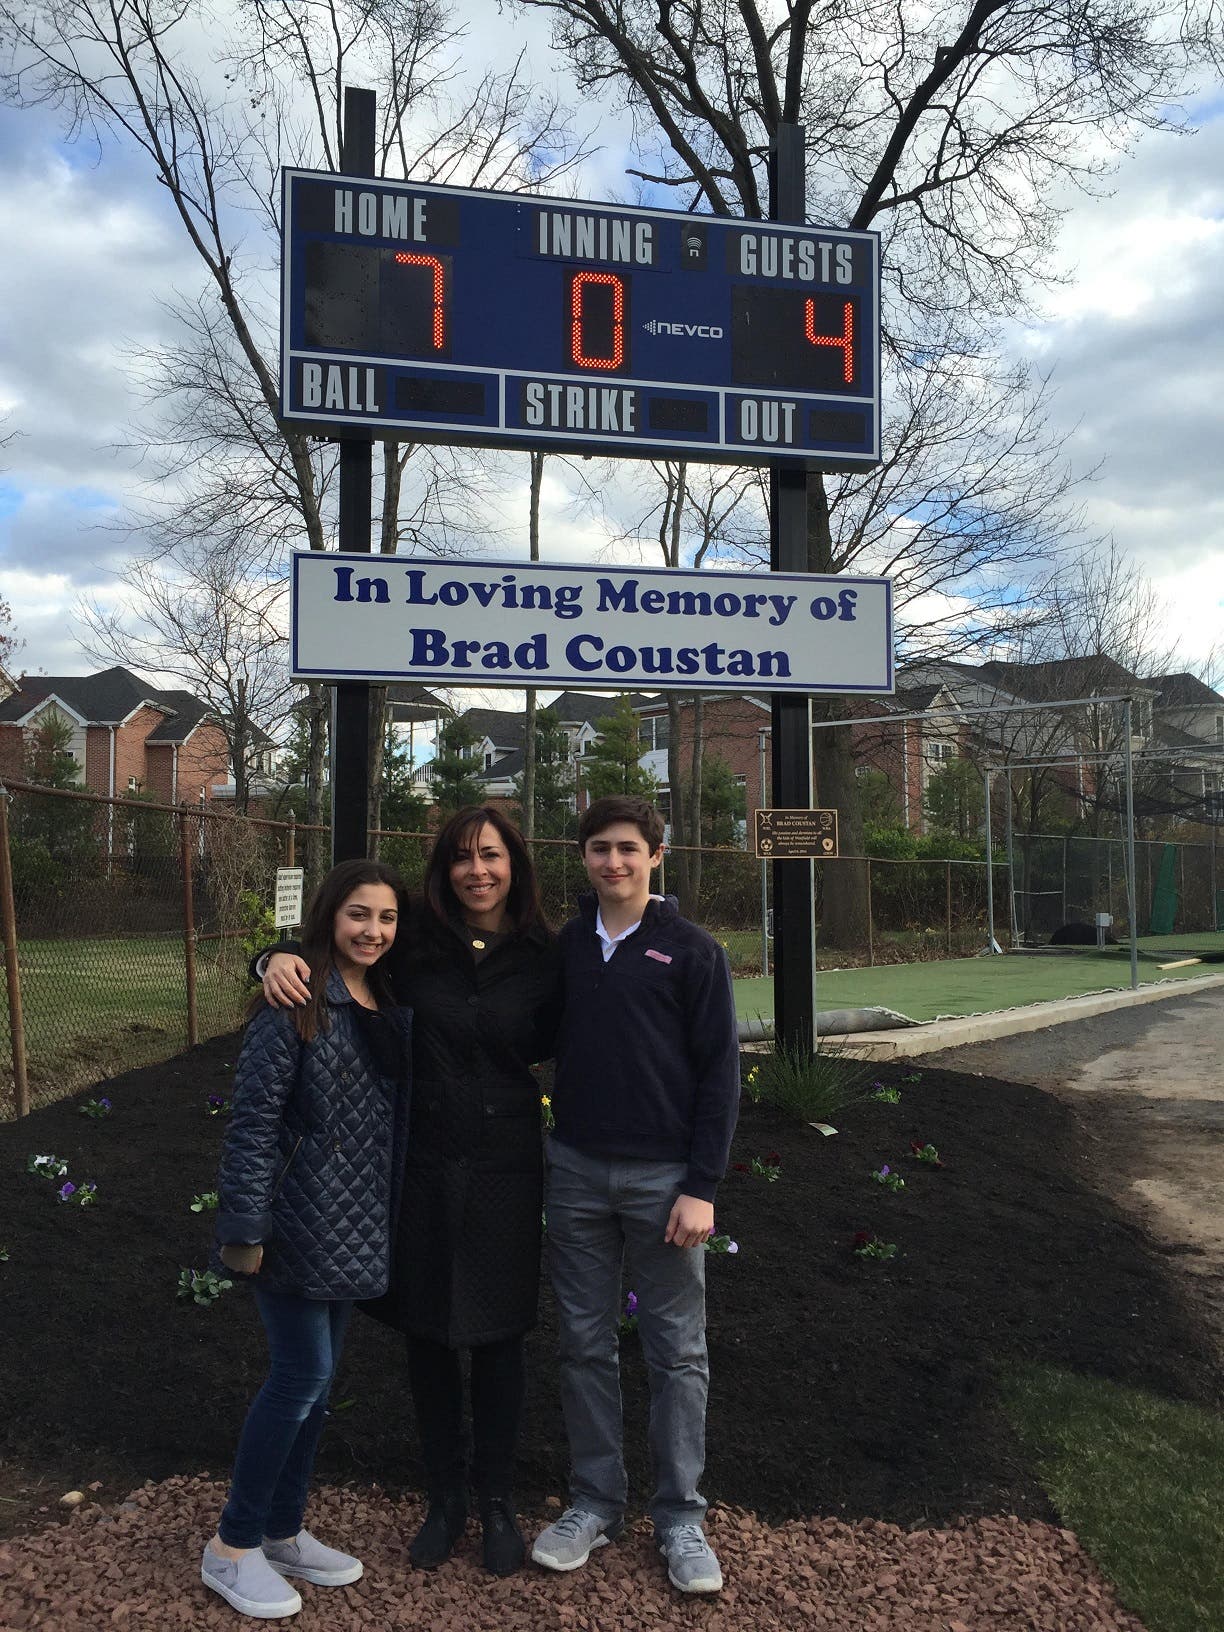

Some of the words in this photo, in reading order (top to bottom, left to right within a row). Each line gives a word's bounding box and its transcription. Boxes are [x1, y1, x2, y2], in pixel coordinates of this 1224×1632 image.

[334, 190, 427, 242] HOME
[539, 211, 653, 265] INNING
[740, 234, 853, 285] GUESTS
[395, 253, 443, 349] 7
[572, 272, 623, 369] 0
[805, 299, 853, 383] 4
[302, 362, 379, 413] BALL
[526, 381, 635, 433] STRIKE
[741, 399, 797, 444] OUT
[332, 567, 390, 604] In
[405, 569, 582, 620] Loving
[595, 578, 799, 626] Memory
[809, 589, 858, 622] of
[408, 628, 549, 671] Brad
[564, 634, 792, 678] Coustan
